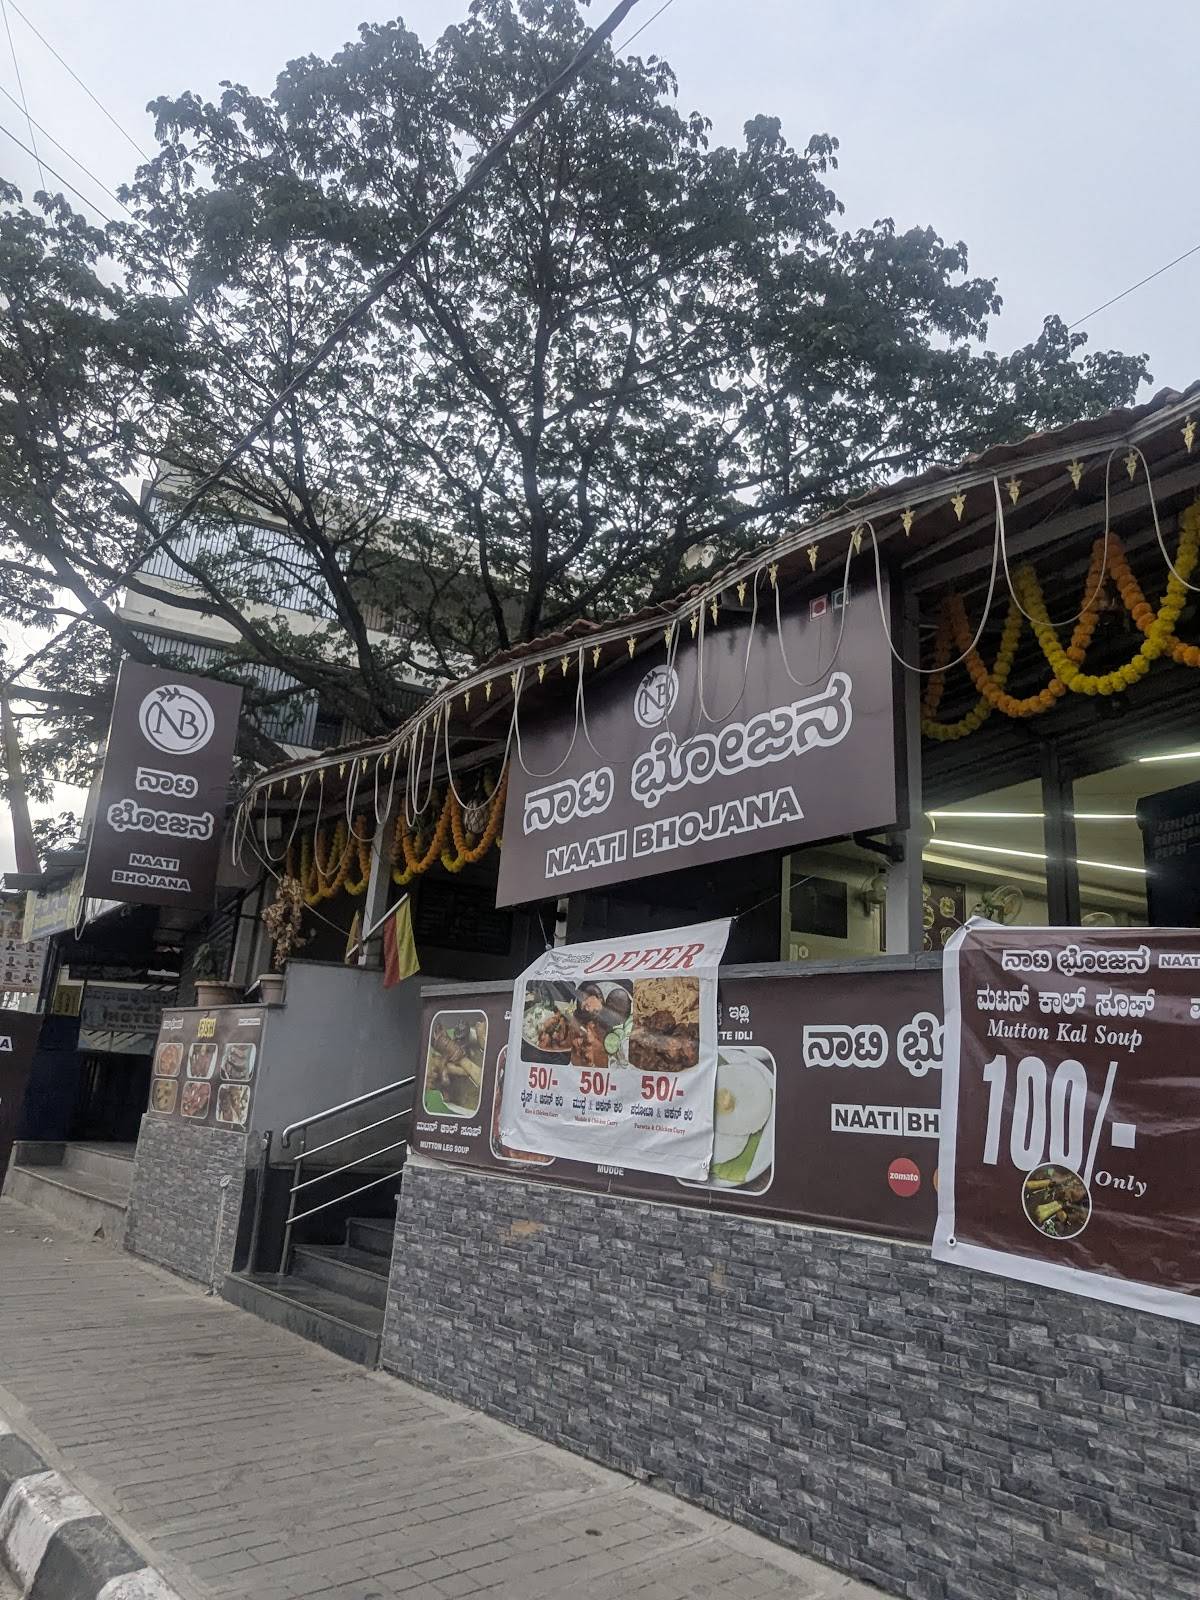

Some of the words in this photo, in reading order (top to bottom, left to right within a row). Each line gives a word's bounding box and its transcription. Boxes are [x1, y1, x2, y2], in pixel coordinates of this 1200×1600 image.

[136, 767, 198, 798] ನಾಟಿ
[524, 767, 614, 834] ನಾಟಿ
[546, 830, 627, 878] NAATI
[633, 786, 803, 857] BHOJANA
[130, 853, 179, 871] NAATI
[112, 870, 190, 891] BHOJANA
[584, 943, 704, 974] OFFER
[1002, 949, 1052, 972] ನಾಟಿ
[976, 982, 1030, 1012] ಮಟನ್
[1038, 986, 1086, 1014] ಕಾಲ್
[1095, 987, 1155, 1018] ಸೂಪ್
[735, 1031, 753, 1040] IDLI
[802, 1024, 888, 1068] ನಾಟಿ
[987, 1019, 1049, 1041] Mutton
[1056, 1023, 1088, 1043] Kal
[1094, 1025, 1143, 1053] Soup
[528, 1066, 558, 1090] 50/-
[580, 1070, 616, 1096] 50/-
[641, 1075, 684, 1102] 50/-
[832, 1106, 901, 1134] NAATI
[982, 1055, 1136, 1191] 100/-
[420, 1141, 442, 1150] MUTTON
[443, 1144, 453, 1152] LEG
[454, 1145, 470, 1154] SOUP
[889, 1171, 919, 1182] zomato
[1095, 1170, 1148, 1198] Only
